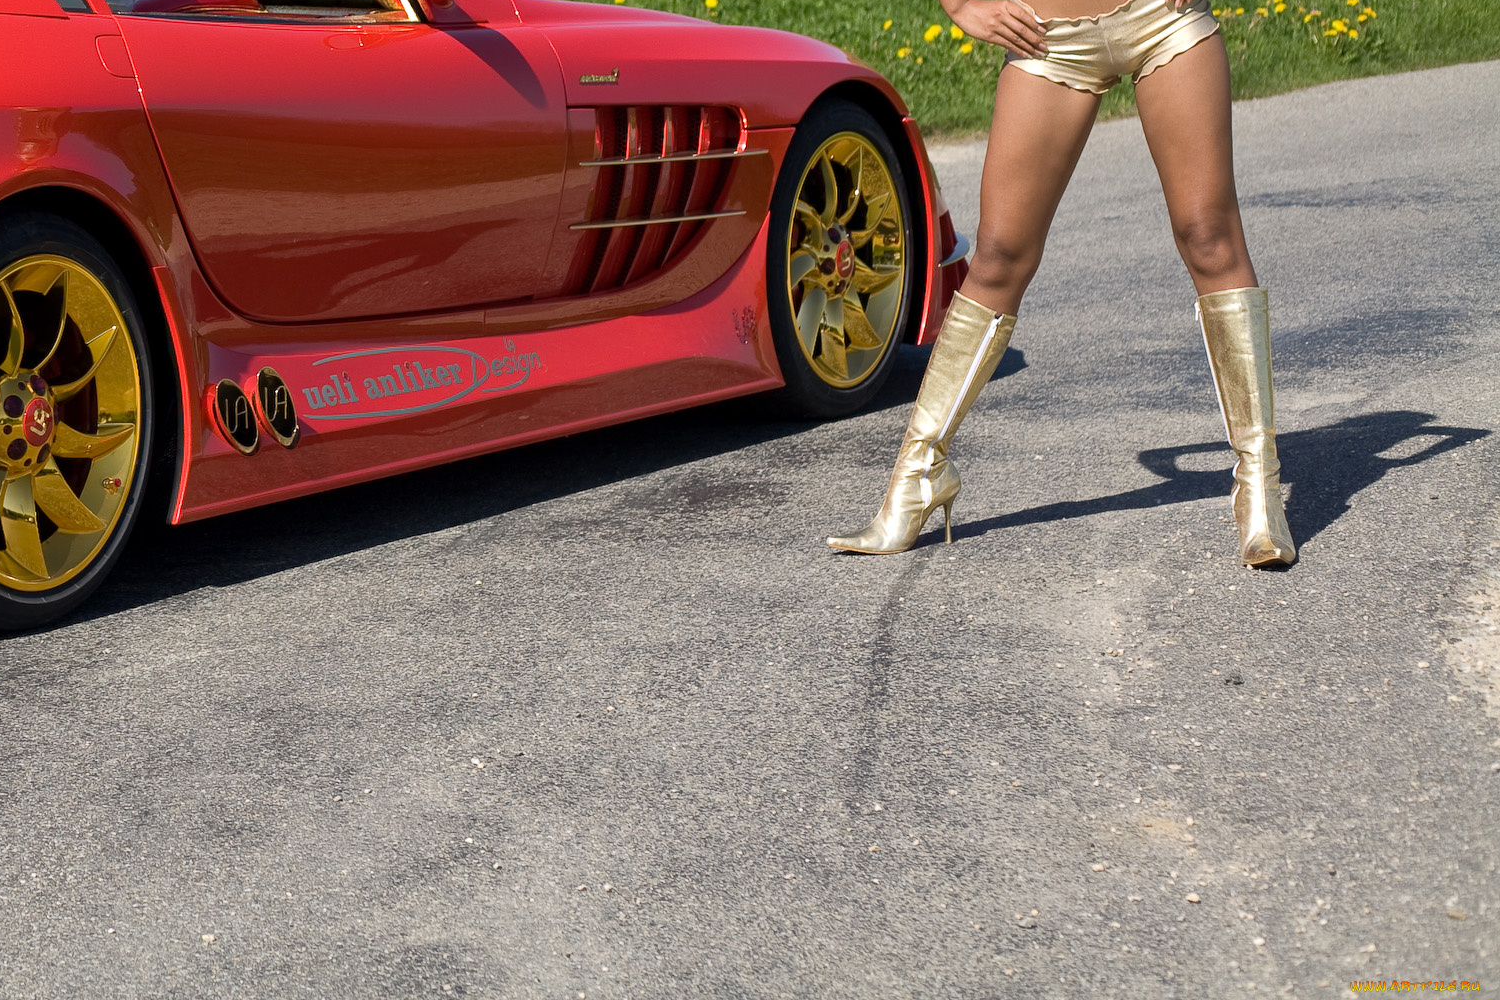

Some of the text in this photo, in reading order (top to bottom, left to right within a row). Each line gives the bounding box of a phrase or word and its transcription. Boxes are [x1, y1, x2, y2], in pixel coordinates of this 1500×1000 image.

[302, 352, 541, 410] ueli anliker Design
